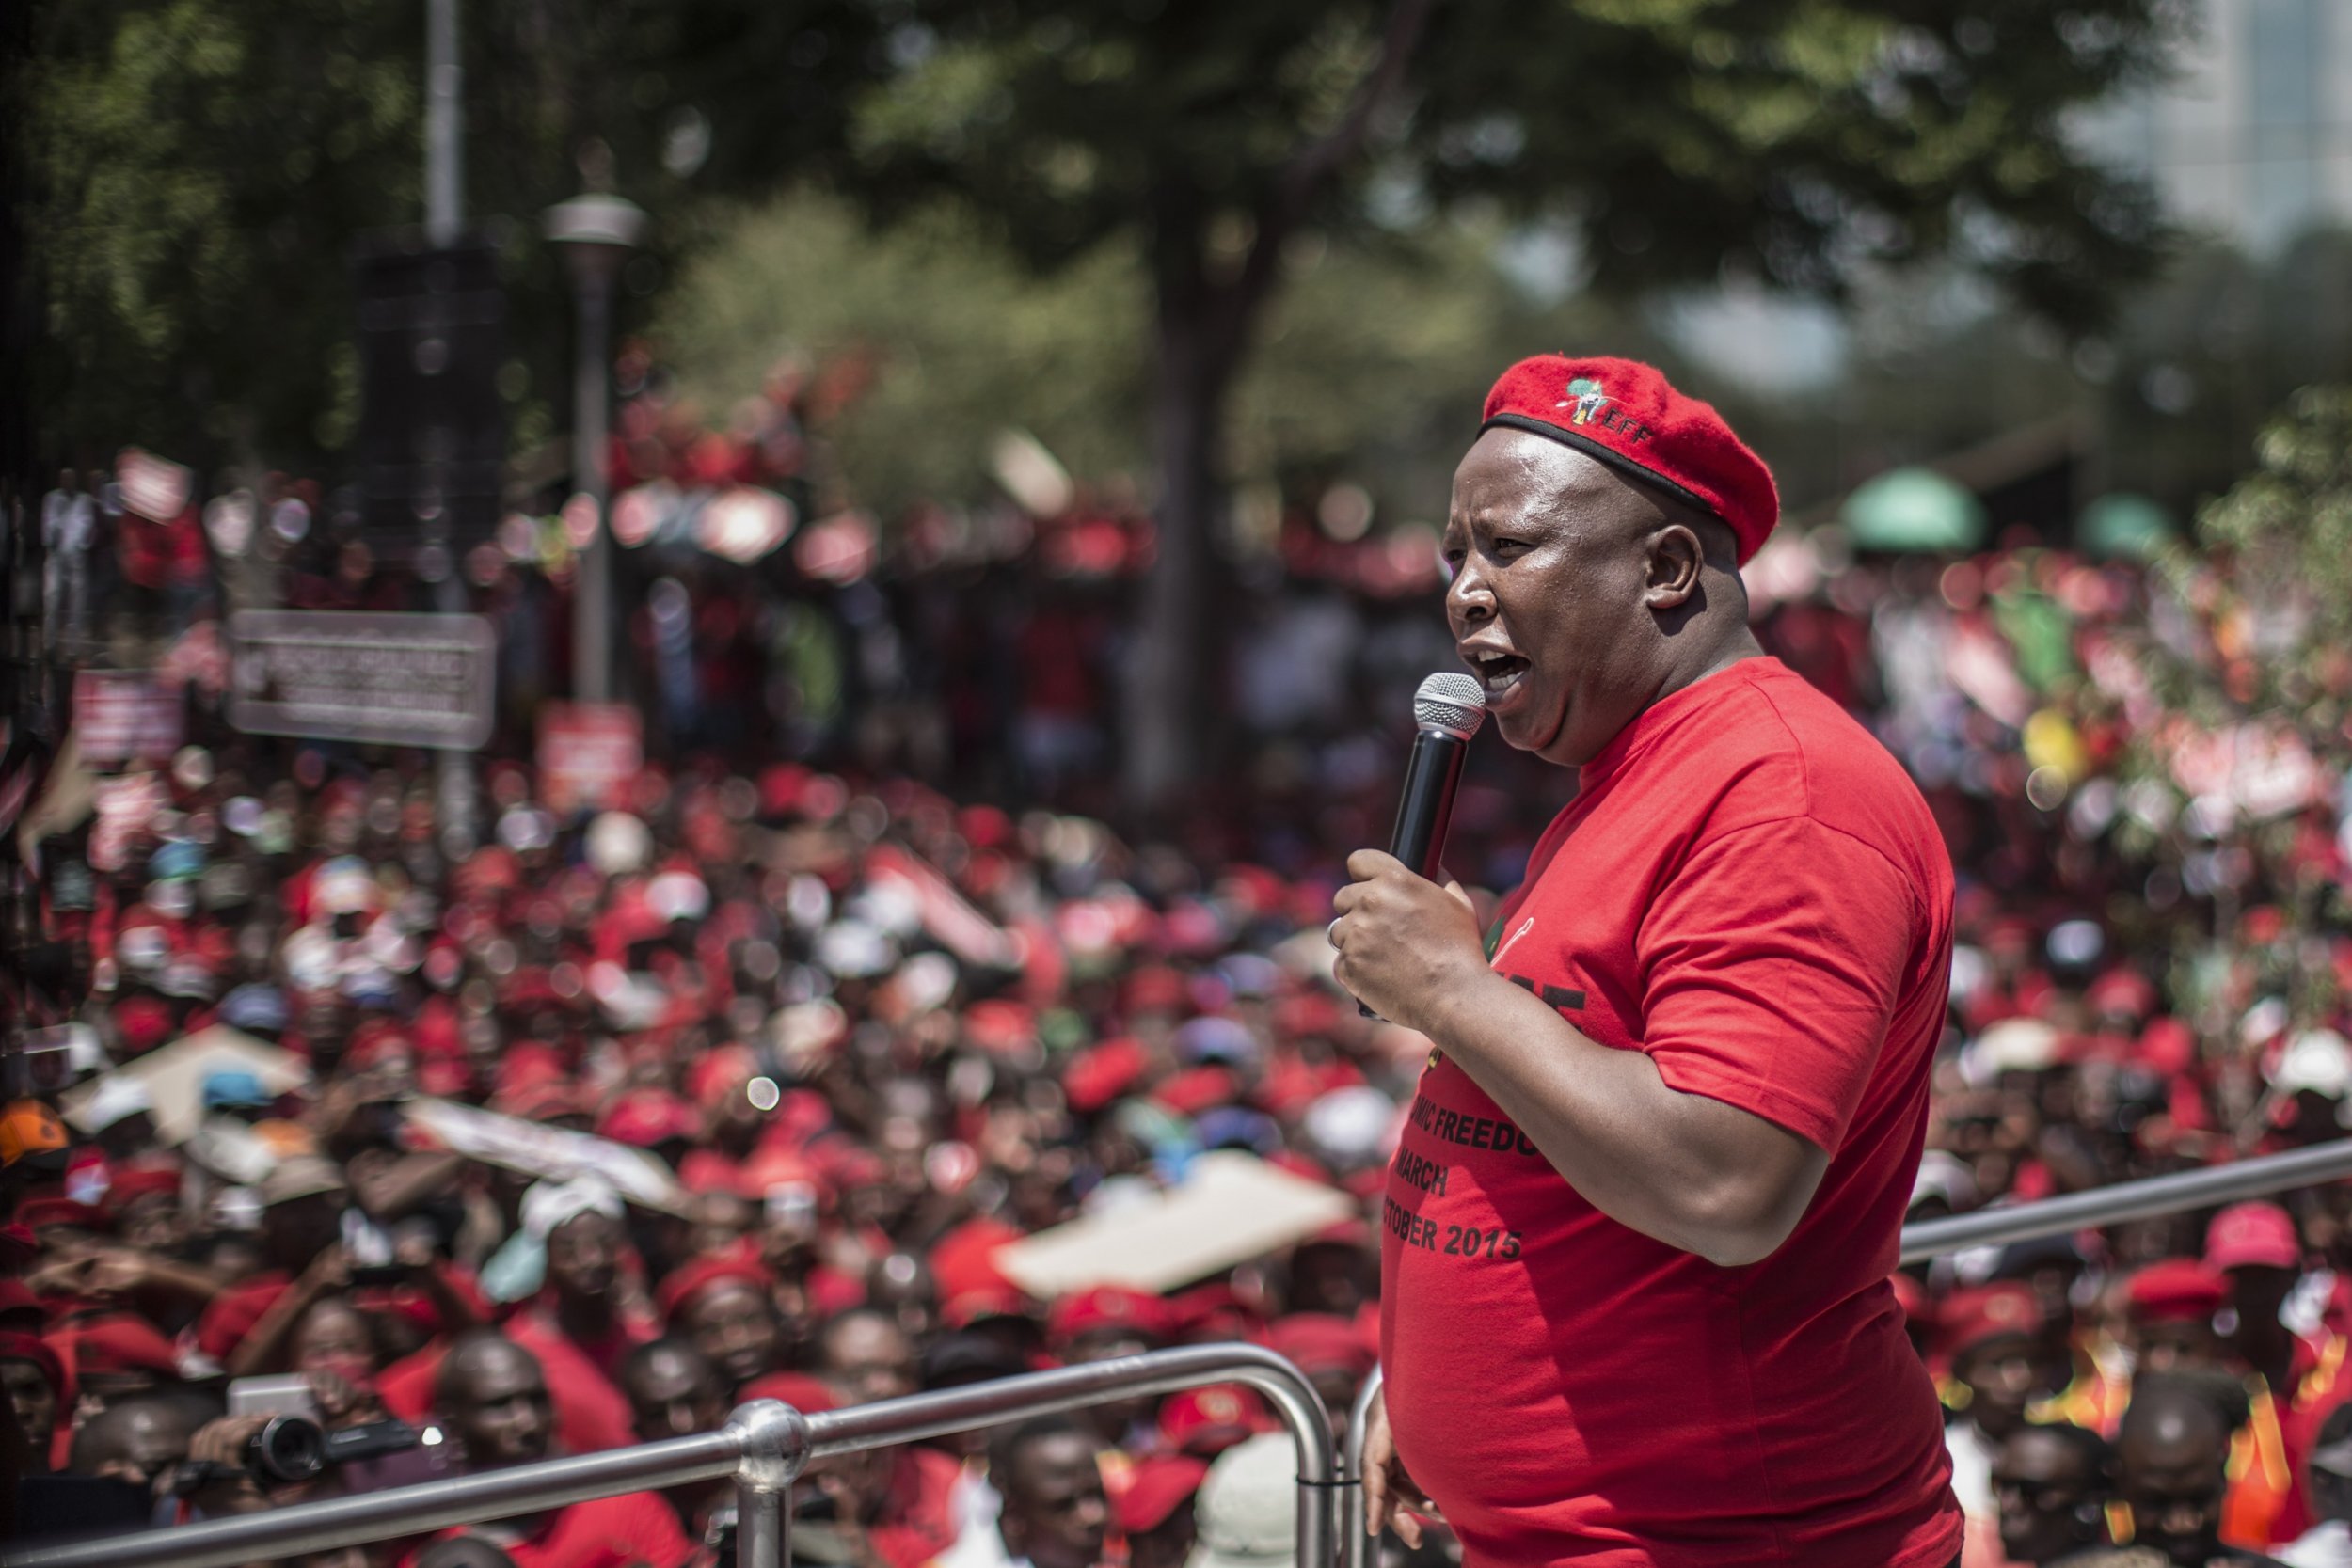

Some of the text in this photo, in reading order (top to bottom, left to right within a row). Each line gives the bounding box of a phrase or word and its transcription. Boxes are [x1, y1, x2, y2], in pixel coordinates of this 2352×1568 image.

[1602, 407, 1654, 443] EFF
[1395, 1148, 1448, 1197] MARCH
[1443, 1225, 1521, 1259] 2015
